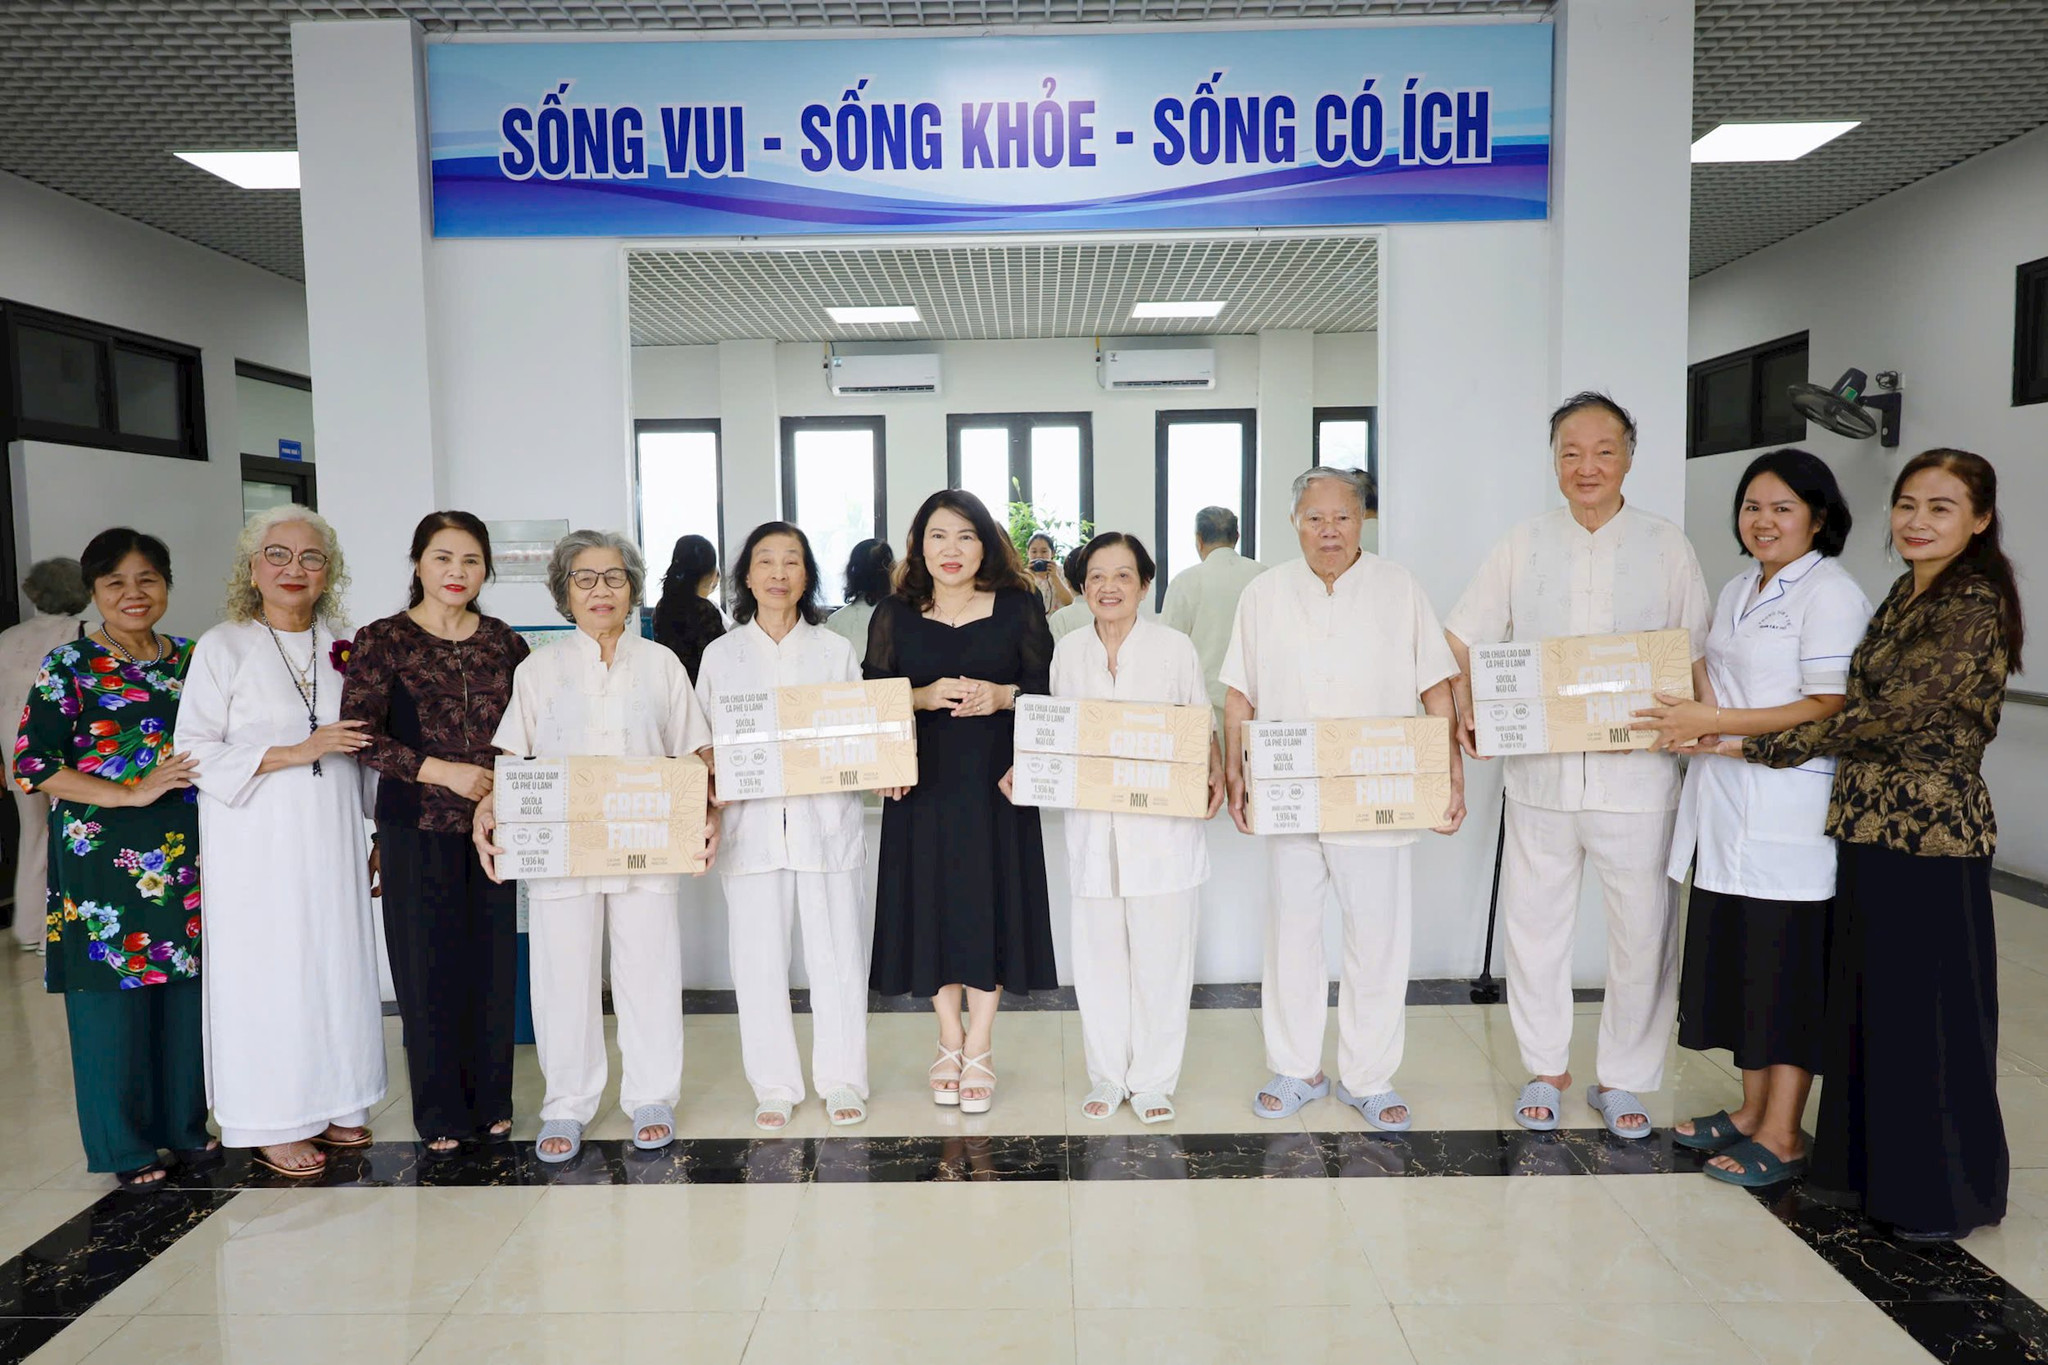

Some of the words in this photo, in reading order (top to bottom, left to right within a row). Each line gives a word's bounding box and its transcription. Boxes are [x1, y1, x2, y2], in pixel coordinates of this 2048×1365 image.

[501, 81, 646, 177] SỐNG
[659, 105, 745, 174] VUI
[763, 136, 782, 151] -
[800, 78, 943, 173] SỐNG
[960, 76, 1097, 170] KHỎE
[1115, 131, 1134, 145] -
[1152, 71, 1297, 166] SỐNG
[1315, 78, 1384, 168] CÓ
[1402, 77, 1490, 167] ÍCH
[1609, 728, 1630, 744] MIX
[840, 770, 859, 786] MIX
[1130, 793, 1148, 807] MIX
[1376, 810, 1394, 825] MIX
[627, 854, 647, 869] MIX
